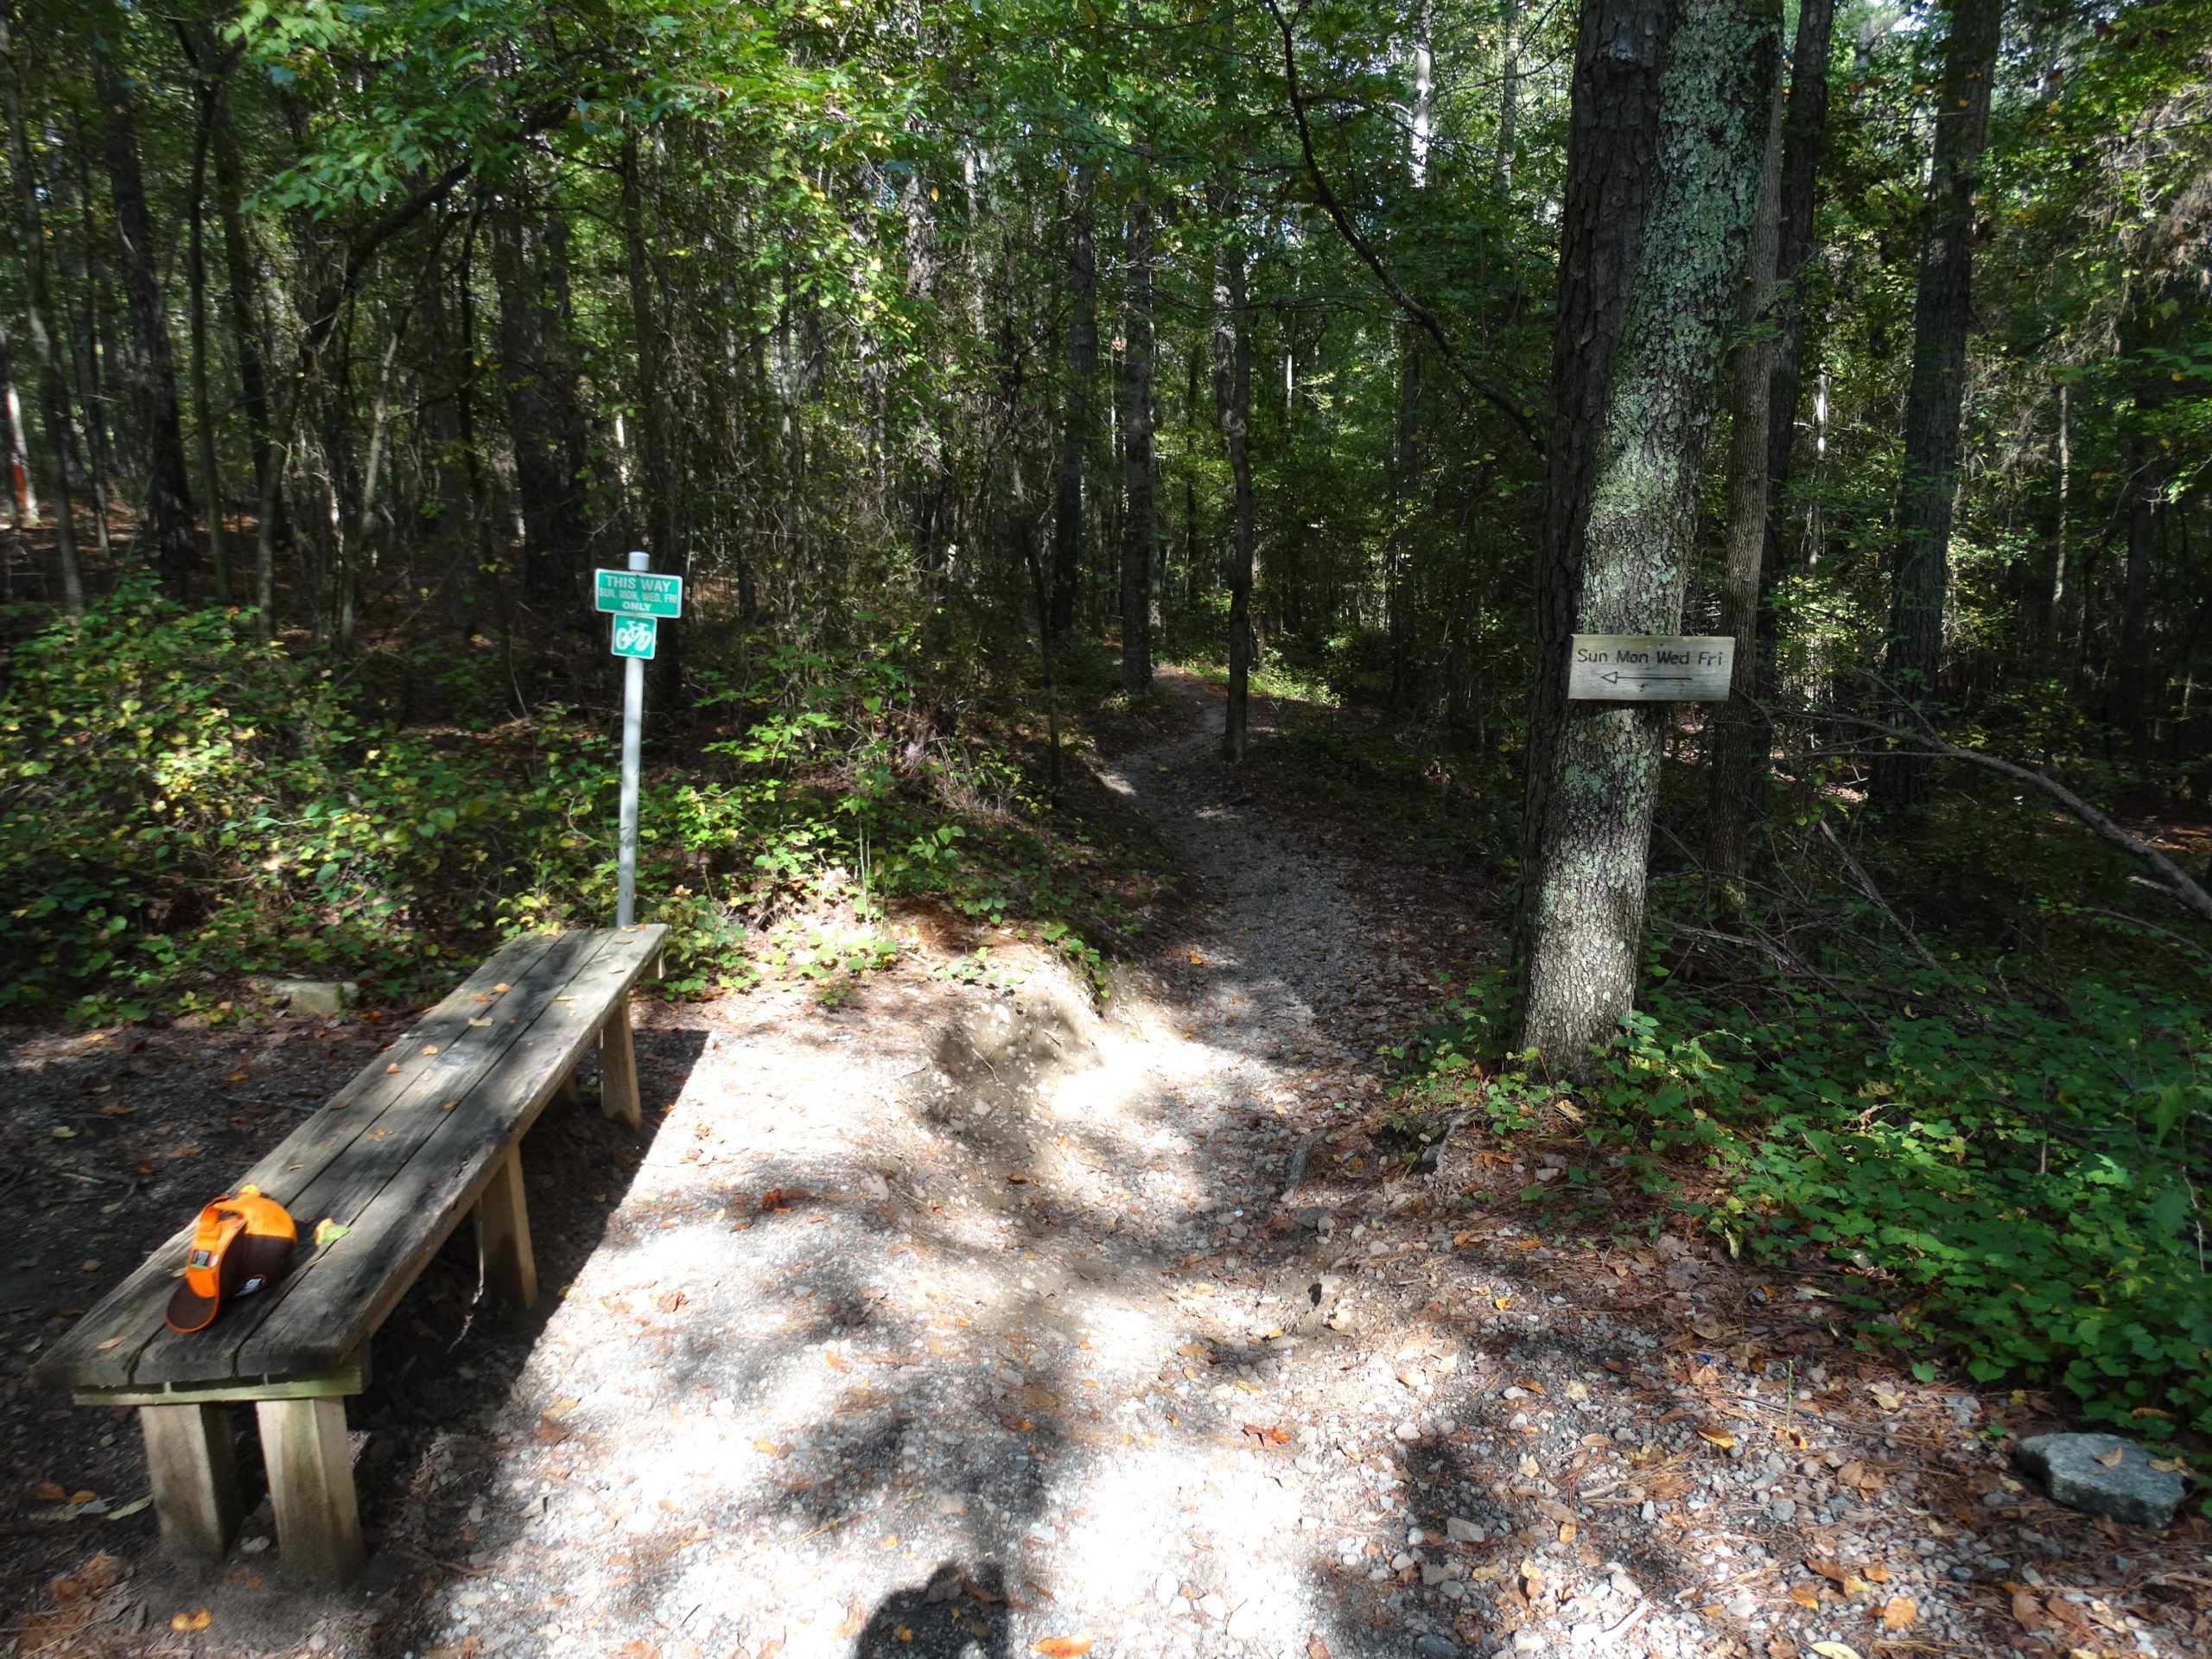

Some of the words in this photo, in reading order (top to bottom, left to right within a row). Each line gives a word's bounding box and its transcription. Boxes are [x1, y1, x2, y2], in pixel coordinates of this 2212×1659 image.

[606, 575, 637, 589] THIS
[640, 579, 671, 592] WAY
[664, 594, 677, 604] FRI
[622, 601, 652, 611] ONLY
[1578, 649, 1608, 663] Sun
[1616, 651, 1649, 664] Mon
[1656, 651, 1690, 664] Wed
[1698, 652, 1723, 665] Fri
